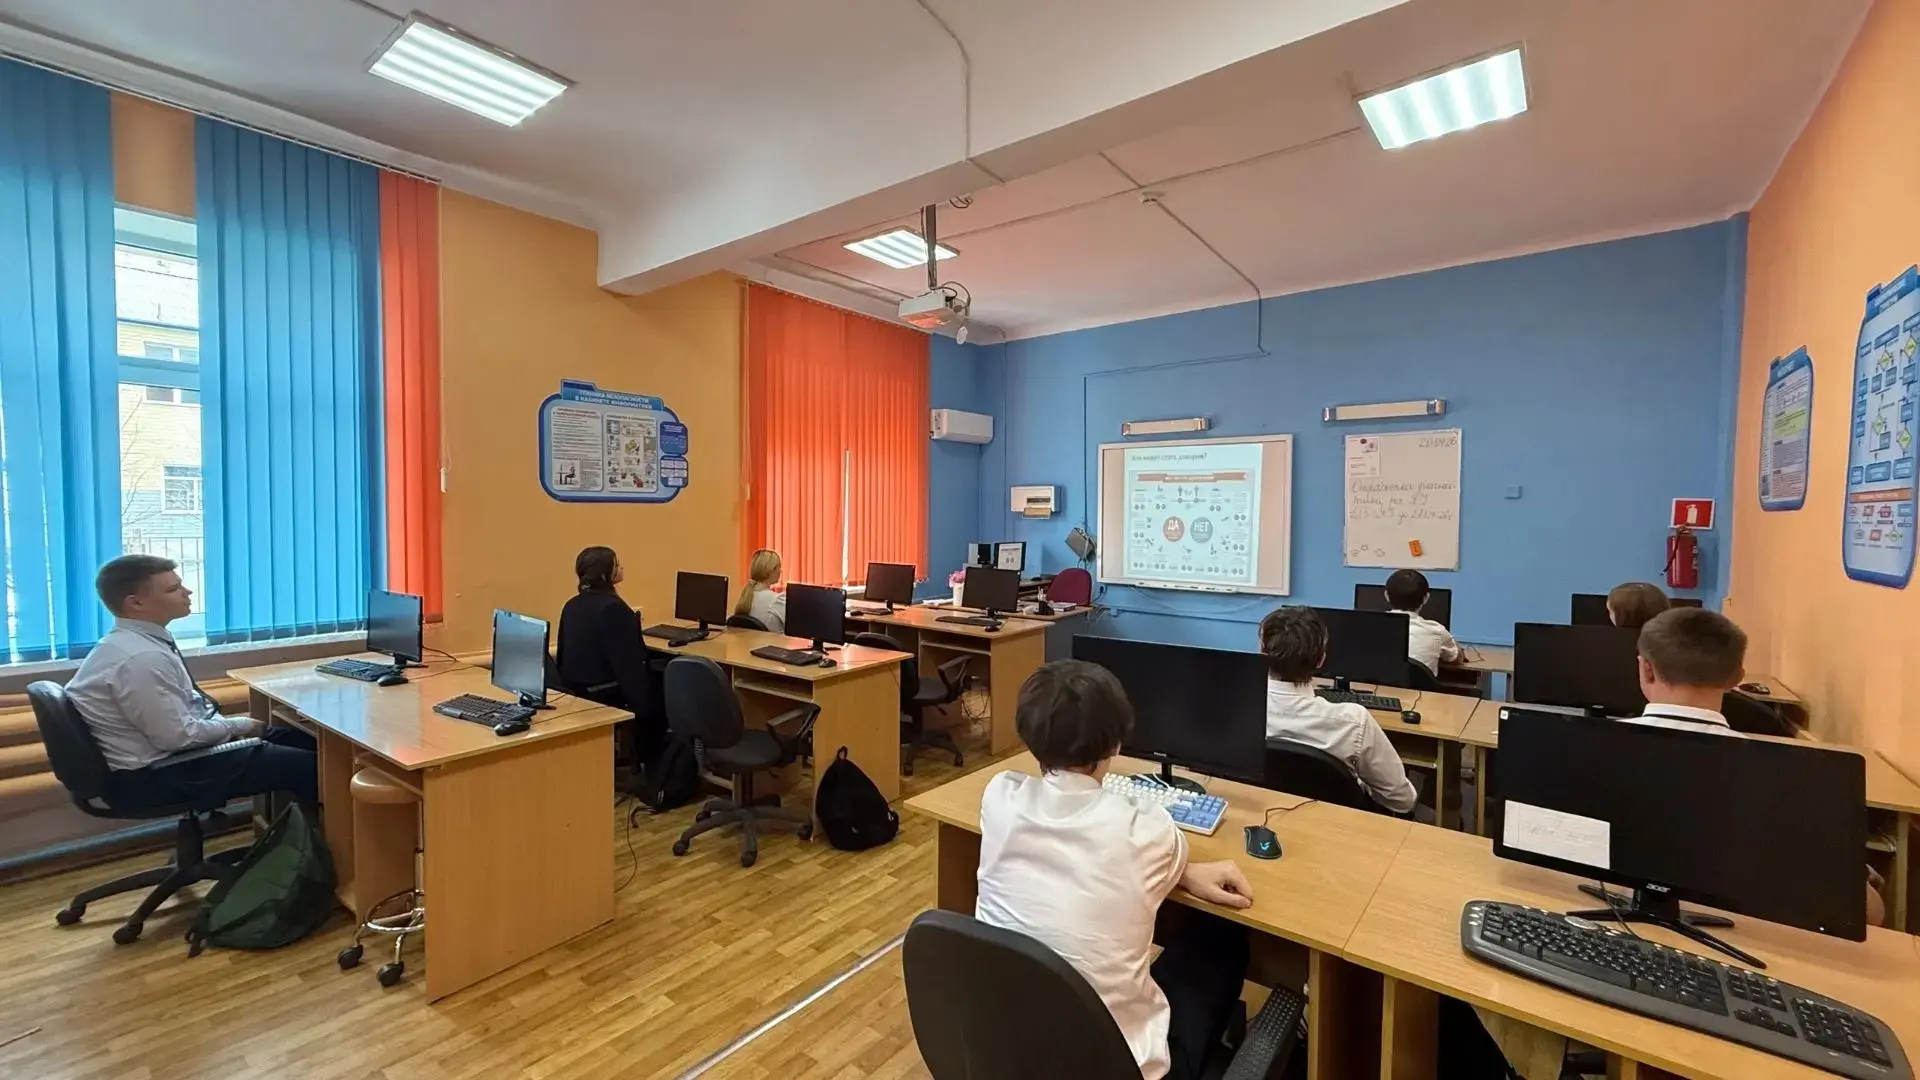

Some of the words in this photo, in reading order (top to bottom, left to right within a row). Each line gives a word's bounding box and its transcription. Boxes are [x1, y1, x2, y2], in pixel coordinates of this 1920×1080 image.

[580, 396, 610, 405] КАБИНЕТЕ
[611, 400, 652, 409] ИНФОРМАТИКИ
[1167, 519, 1179, 531] ДА
[1194, 520, 1209, 533] НЕТ
[1645, 883, 1671, 893] acer
